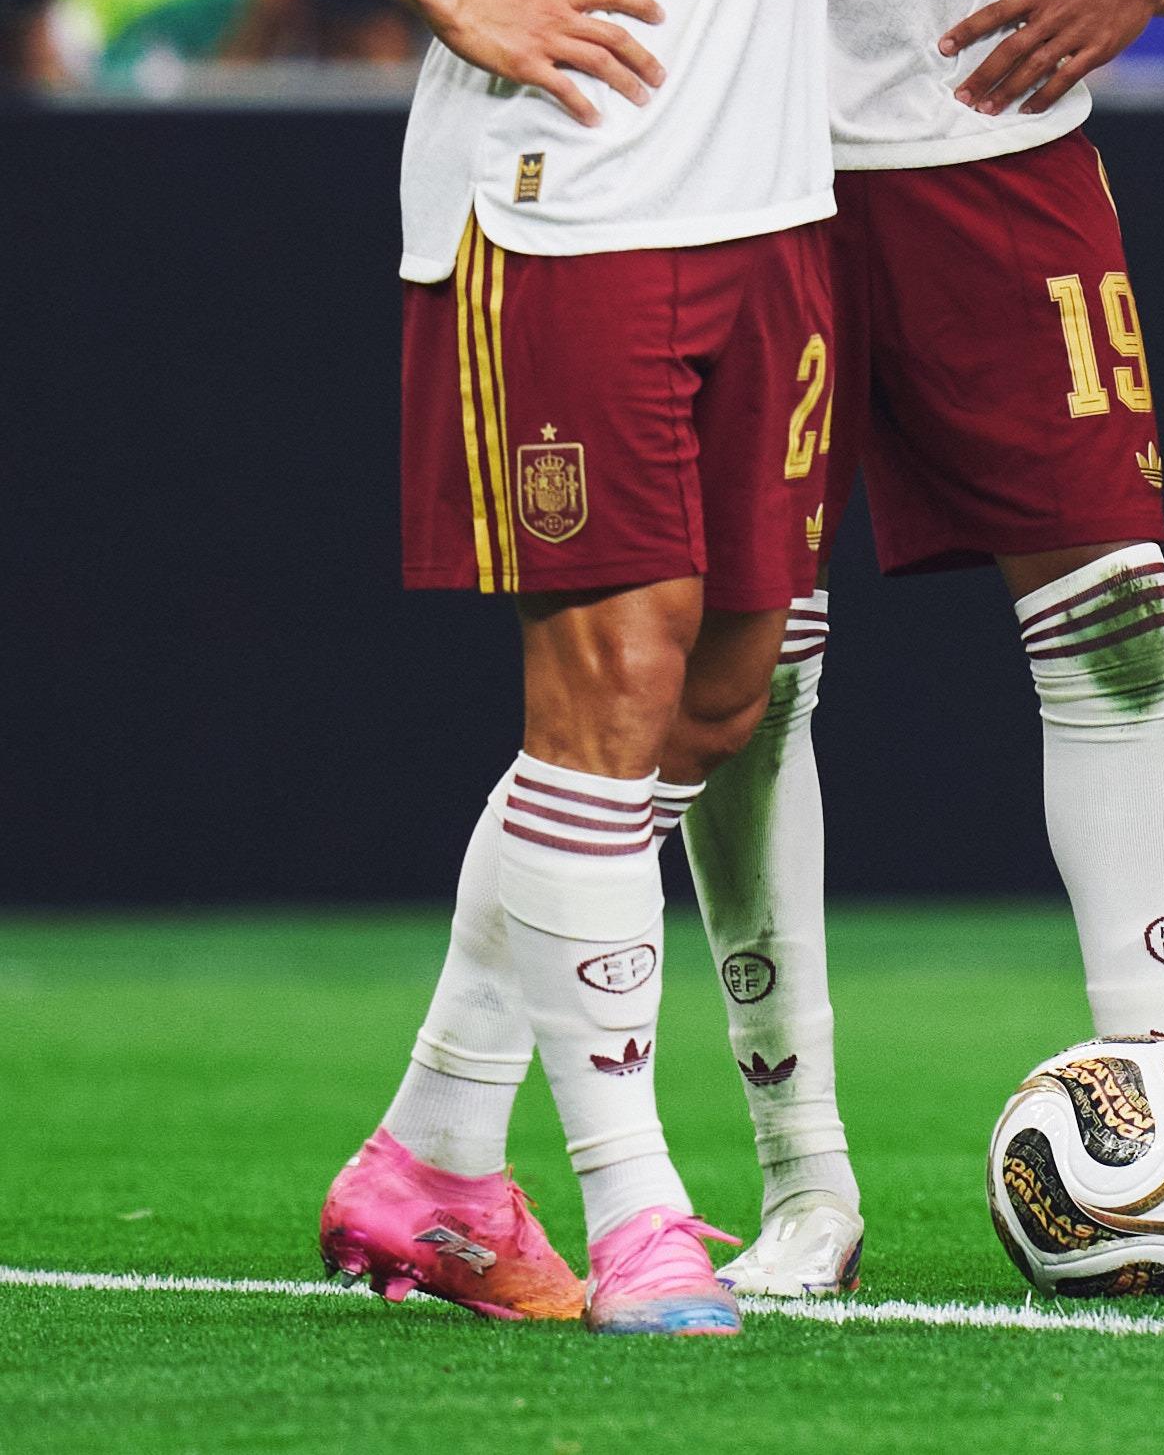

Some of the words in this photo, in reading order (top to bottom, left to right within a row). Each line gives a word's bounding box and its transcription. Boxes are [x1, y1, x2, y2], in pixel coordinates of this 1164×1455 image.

[1046, 271, 1152, 419] 19
[729, 964, 758, 978] RF
[731, 979, 759, 993] EF
[1010, 1158, 1095, 1239] DALLAS
